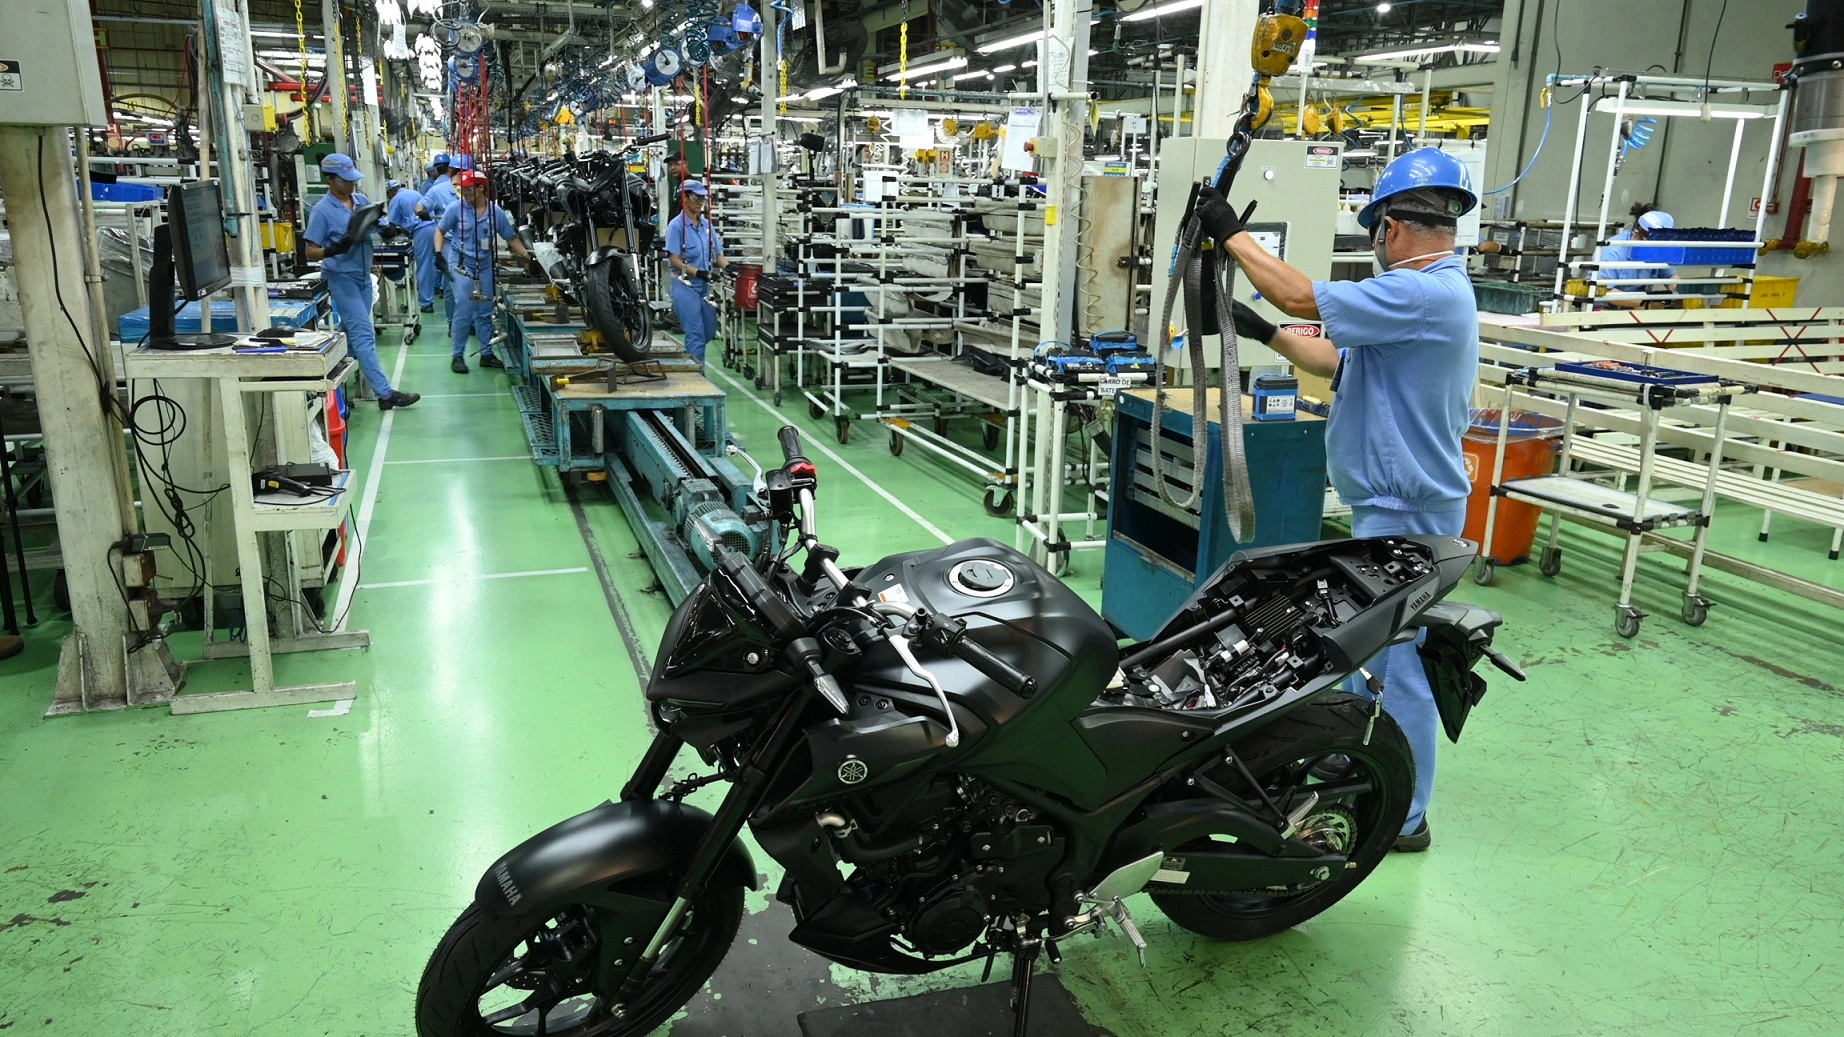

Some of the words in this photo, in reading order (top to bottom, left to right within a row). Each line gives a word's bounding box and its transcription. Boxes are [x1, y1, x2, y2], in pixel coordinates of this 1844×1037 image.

[941, 151, 949, 159] H
[1121, 378, 1130, 386] DE
[1409, 591, 1432, 611] YAMAHA
[494, 861, 521, 906] YAMAHA
